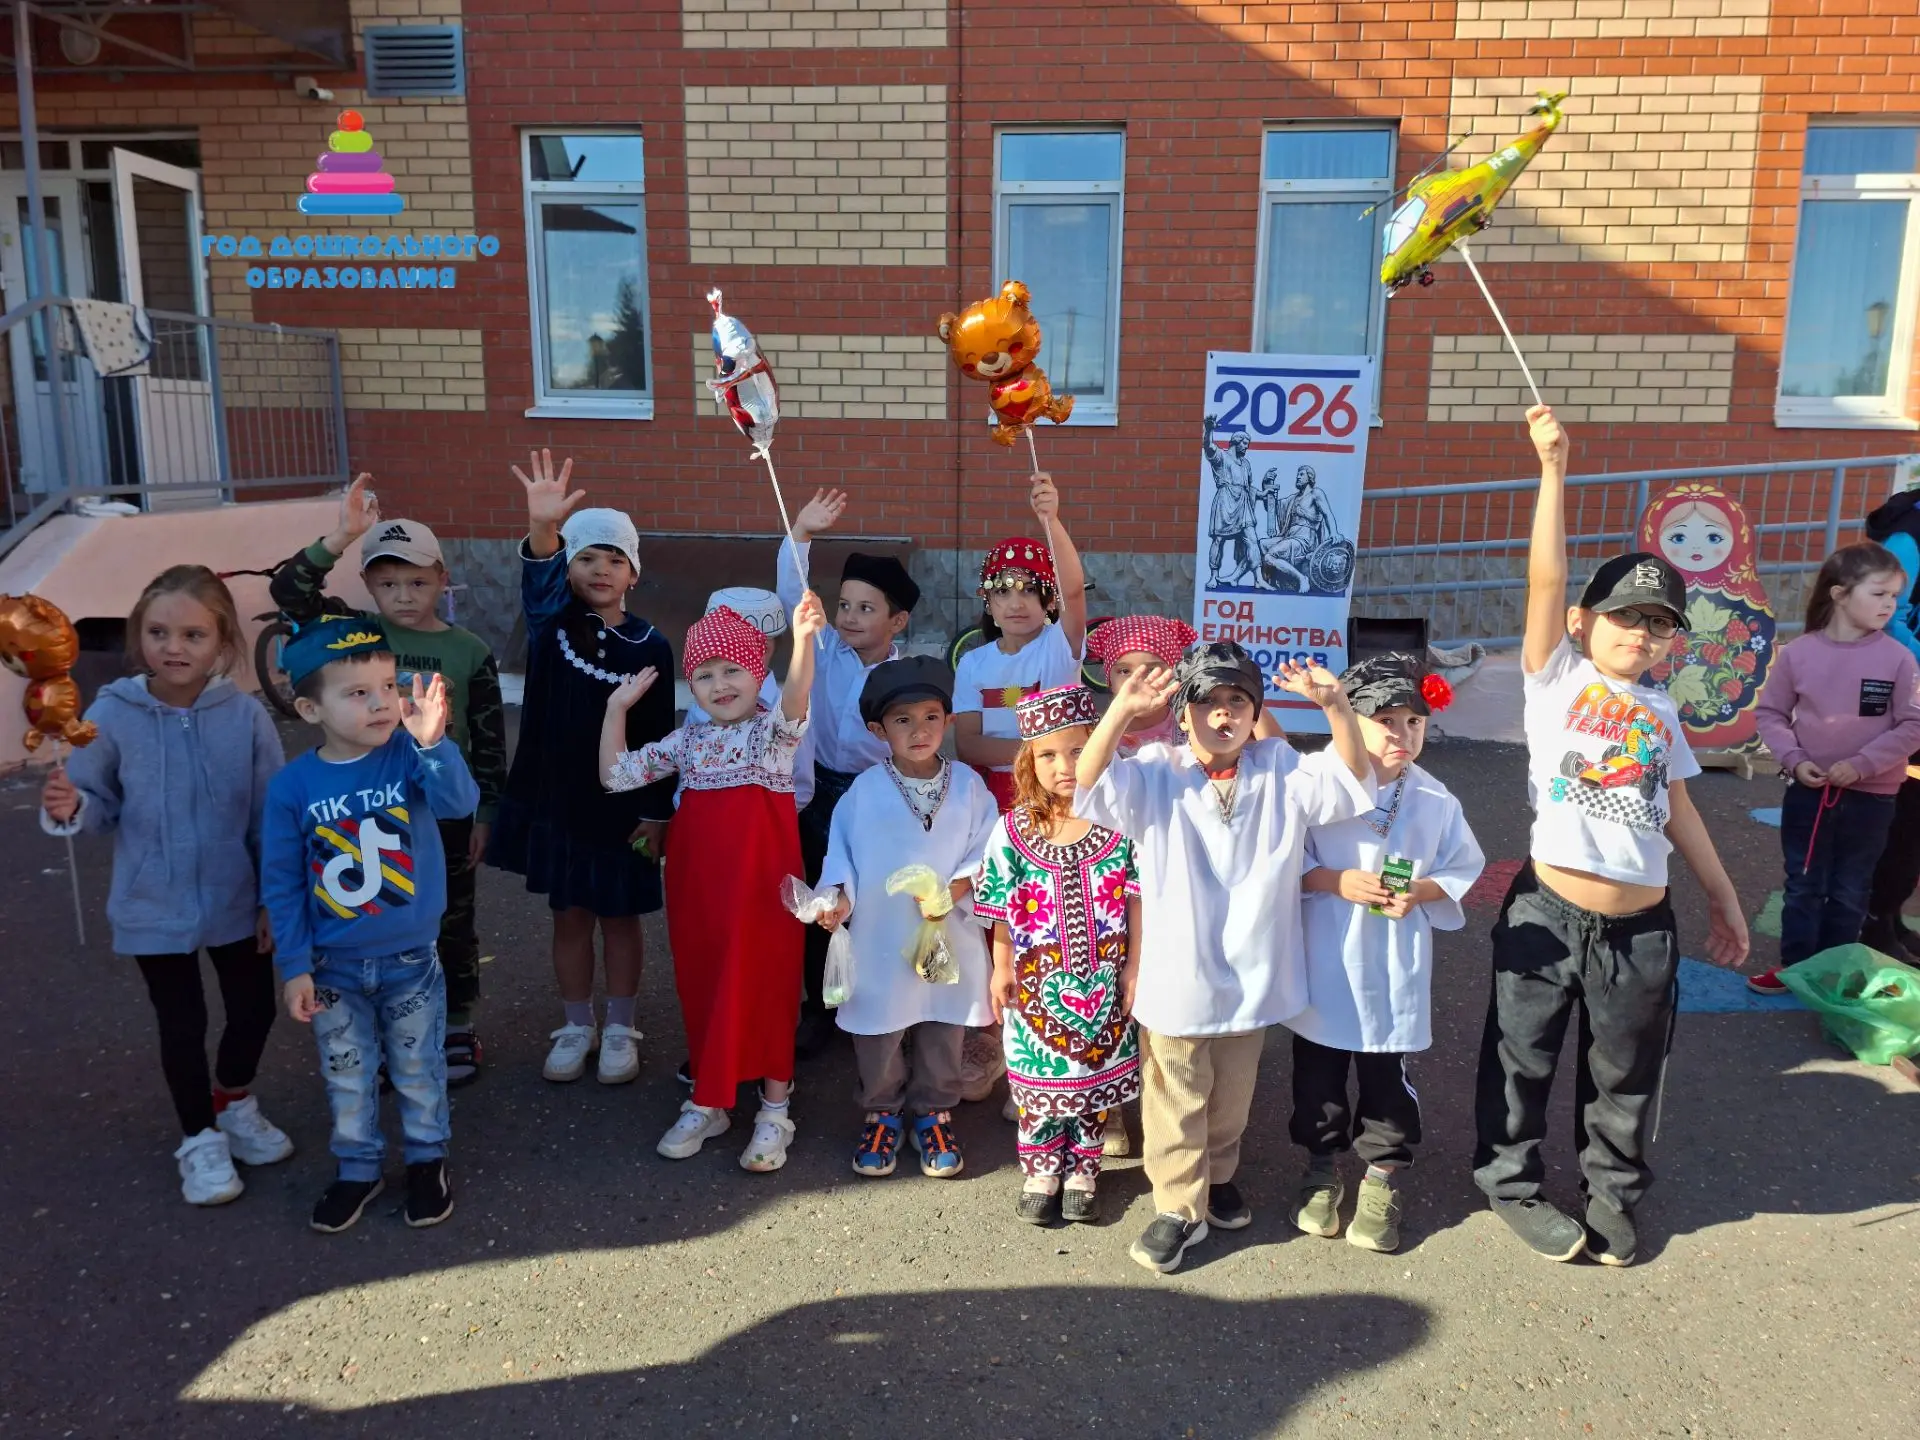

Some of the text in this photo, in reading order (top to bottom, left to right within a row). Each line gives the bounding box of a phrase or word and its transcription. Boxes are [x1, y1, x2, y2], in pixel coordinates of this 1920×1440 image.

[1213, 381, 1358, 438] 2026
[379, 534, 412, 543] adidas
[1203, 600, 1254, 623] ГОД
[1202, 623, 1343, 648] ЕДИНСТВА
[1564, 713, 1630, 744] TEAM
[1550, 777, 1569, 803] 5
[1585, 808, 1608, 821] FAST
[1608, 815, 1621, 824] AS
